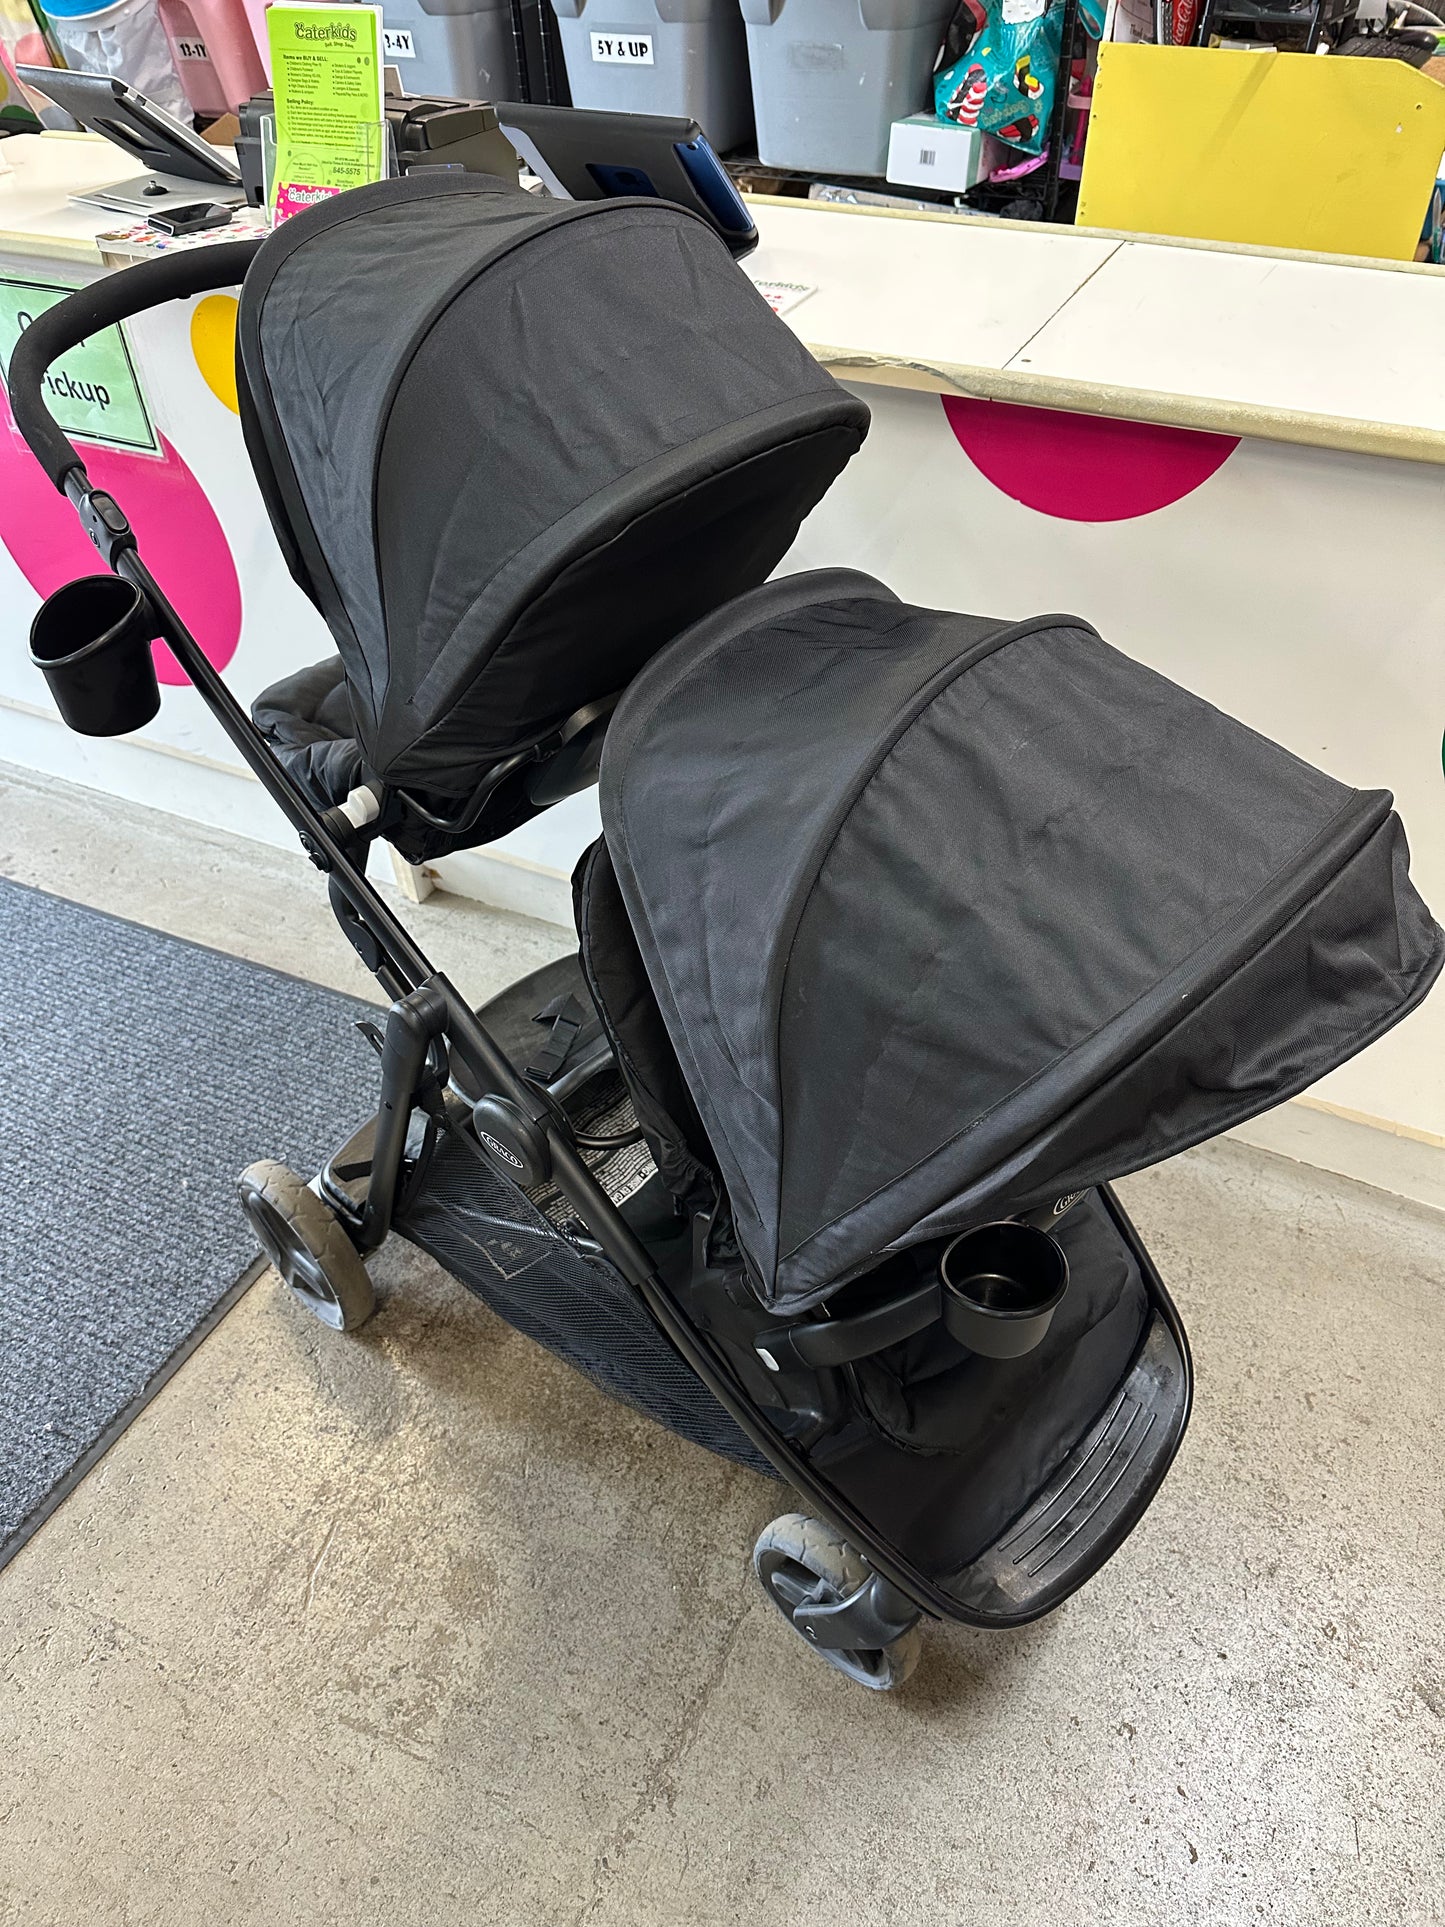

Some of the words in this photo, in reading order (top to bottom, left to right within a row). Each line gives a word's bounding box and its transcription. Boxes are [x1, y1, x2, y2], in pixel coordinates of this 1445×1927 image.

[598, 40, 613, 55] 5Y
[617, 41, 625, 56] &
[628, 42, 648, 57] UP
[40, 370, 110, 411] ickup
[486, 1136, 519, 1165] GRACO
